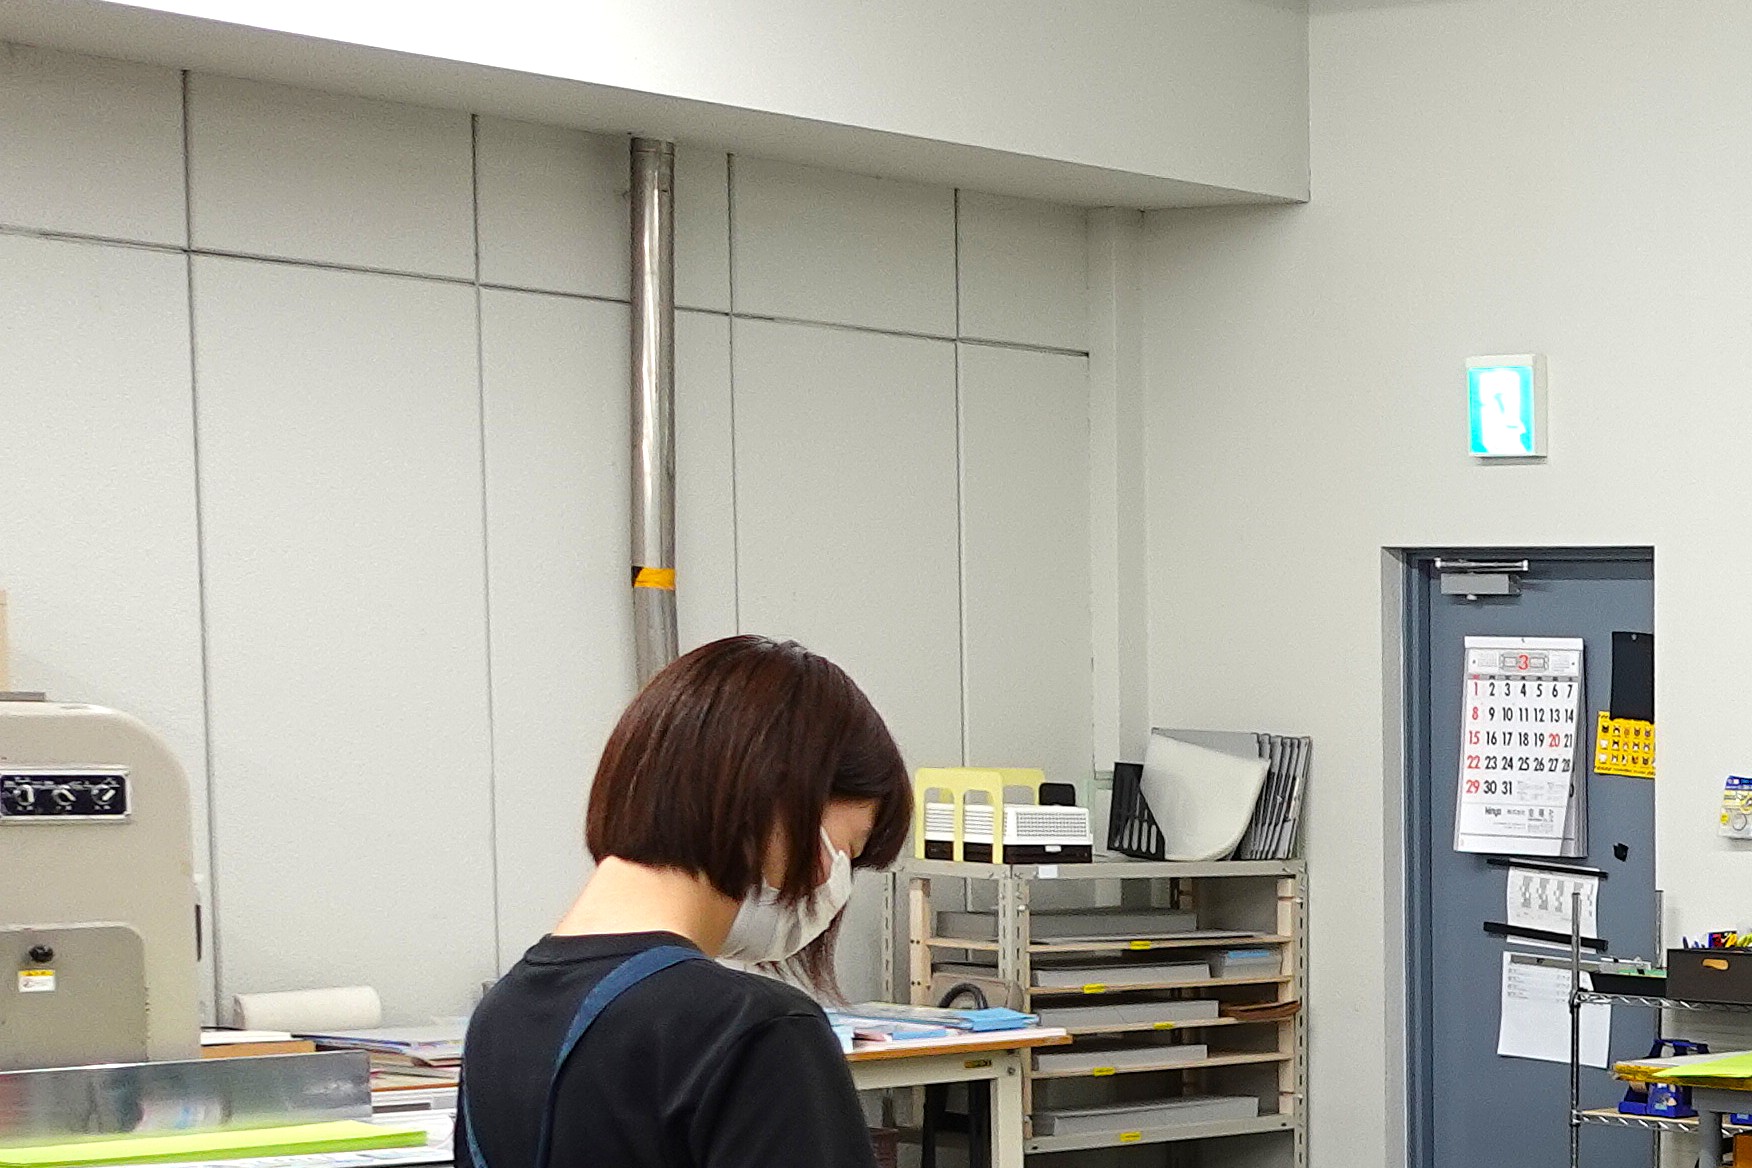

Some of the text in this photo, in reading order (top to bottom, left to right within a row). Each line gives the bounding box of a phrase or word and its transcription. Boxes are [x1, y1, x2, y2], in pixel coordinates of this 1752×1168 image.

[1518, 654, 1529, 671] 3
[1489, 682, 1495, 696] 2
[1504, 682, 1511, 696] 3
[1520, 683, 1527, 697] 4
[1536, 683, 1543, 697] 5
[1551, 684, 1558, 698] 6
[1567, 684, 1573, 698] 7
[1472, 707, 1573, 723] 8 9 10 11 12 13 14
[1469, 731, 1572, 748] 15 16 17 18 19 20 21
[1468, 755, 1570, 772] 22 23 24 25 26 27 28
[1467, 780, 1480, 793] 29
[1484, 780, 1497, 794] 30
[1502, 781, 1512, 795] 31
